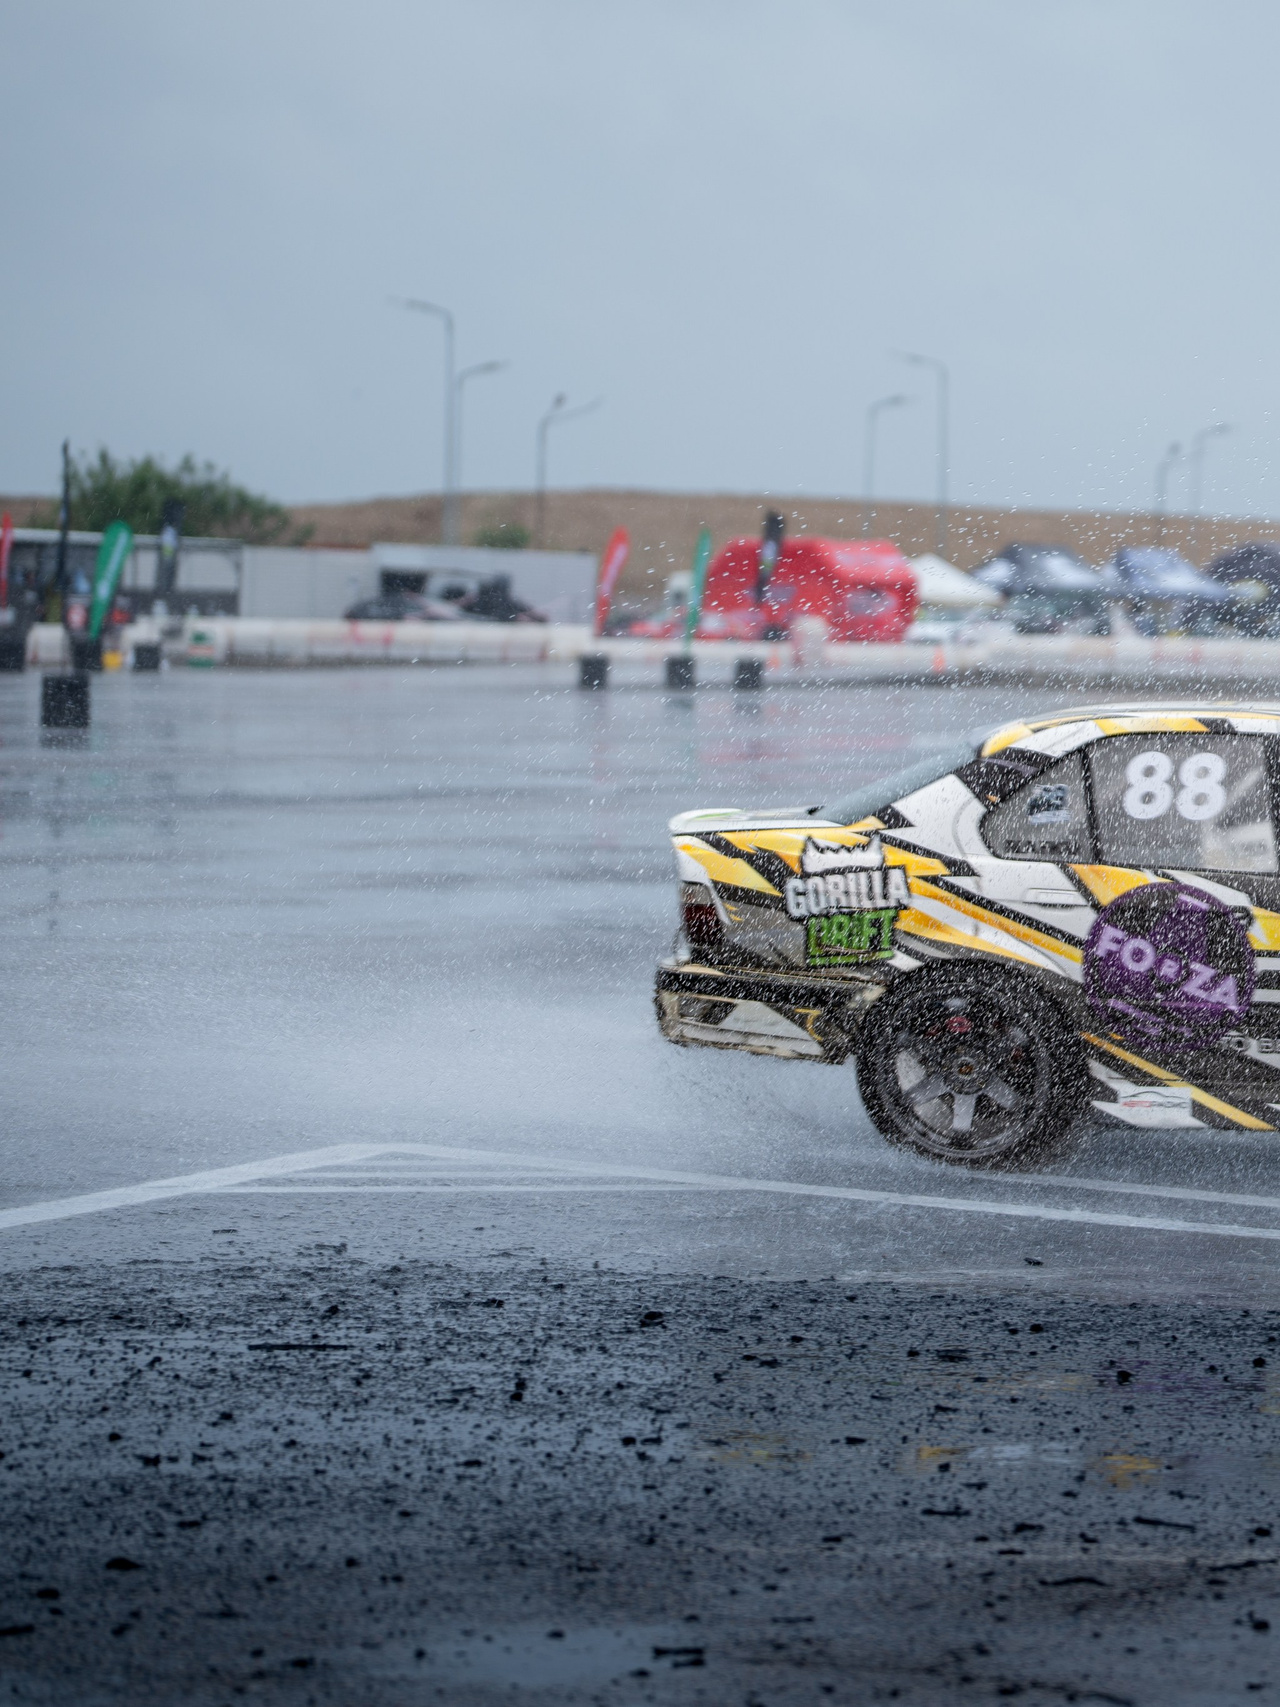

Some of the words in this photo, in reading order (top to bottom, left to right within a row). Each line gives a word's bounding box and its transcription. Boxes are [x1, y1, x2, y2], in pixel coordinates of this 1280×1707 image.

[1123, 751, 1227, 820] 88
[785, 868, 910, 918] GORILLA
[807, 910, 898, 956] DRIFT
[1096, 925, 1239, 1010] FORZA
